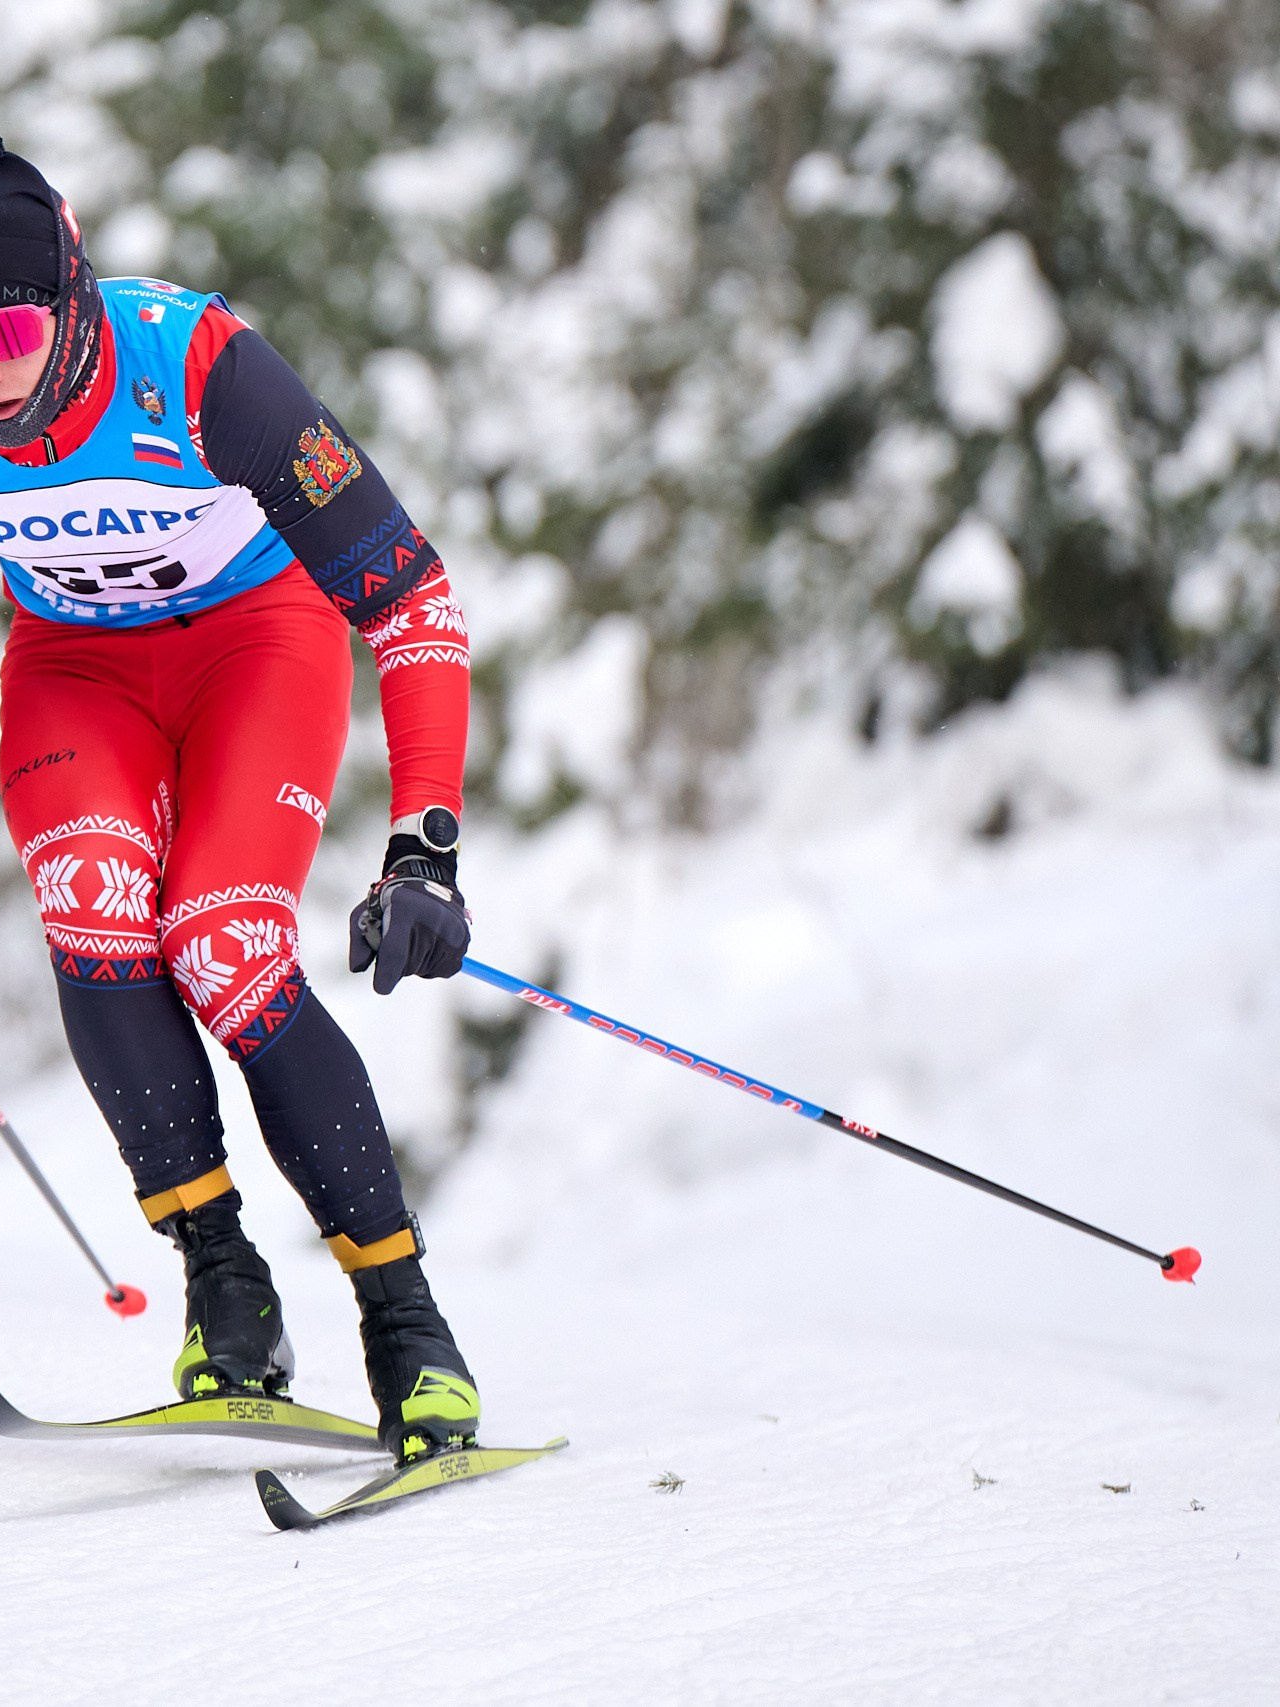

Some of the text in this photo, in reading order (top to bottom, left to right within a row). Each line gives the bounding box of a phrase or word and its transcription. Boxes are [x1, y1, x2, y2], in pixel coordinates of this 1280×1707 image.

[115, 289, 198, 311] РУСКЛИМАТ
[276, 783, 327, 830] KV
[226, 1400, 276, 1422] FISCHER
